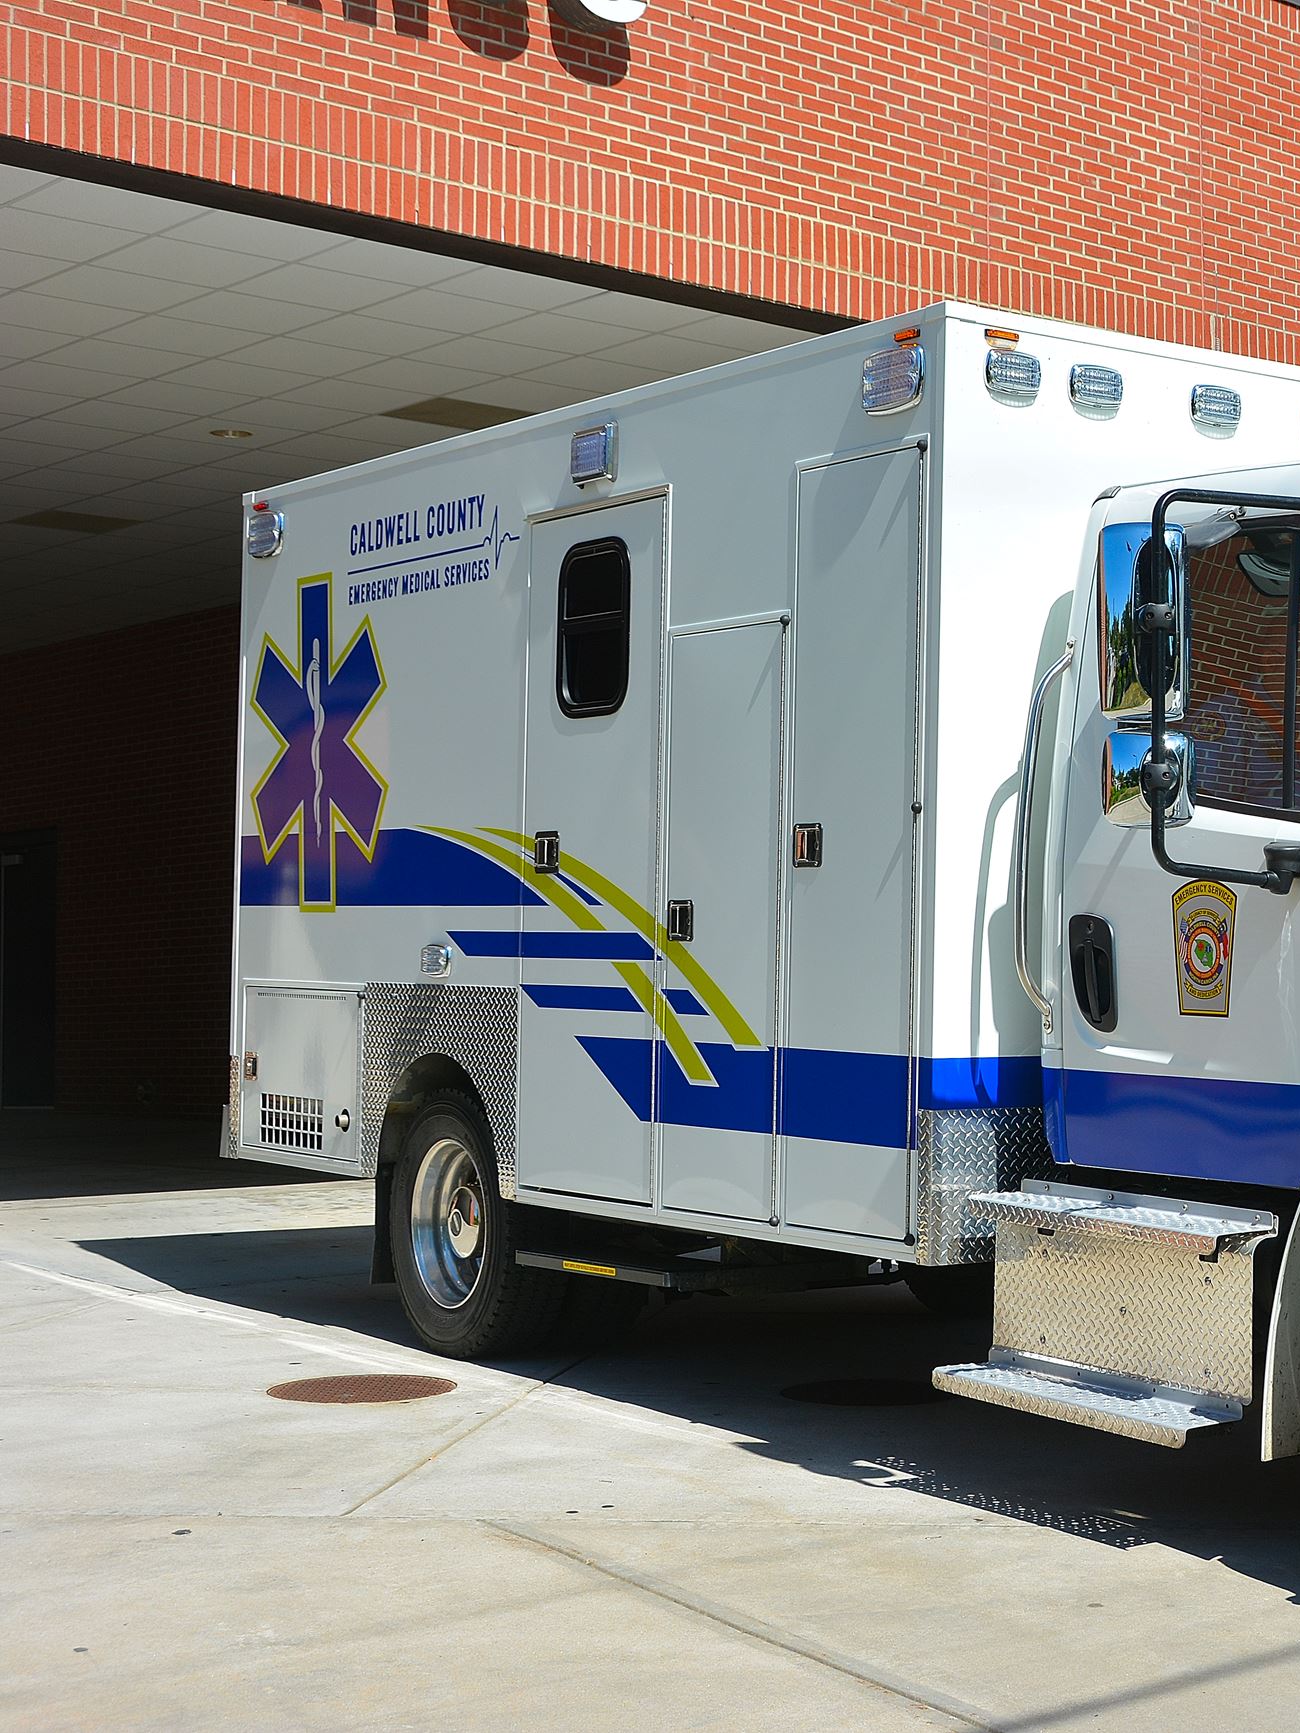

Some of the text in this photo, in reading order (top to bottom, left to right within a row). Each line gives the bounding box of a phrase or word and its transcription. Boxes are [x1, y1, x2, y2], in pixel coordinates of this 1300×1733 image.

[350, 494, 485, 556] CALDWELL COUNTY
[348, 558, 490, 606] EMERGENCY MEDICAL SERVICES
[1175, 885, 1234, 906] EMERGENCY SERVICES
